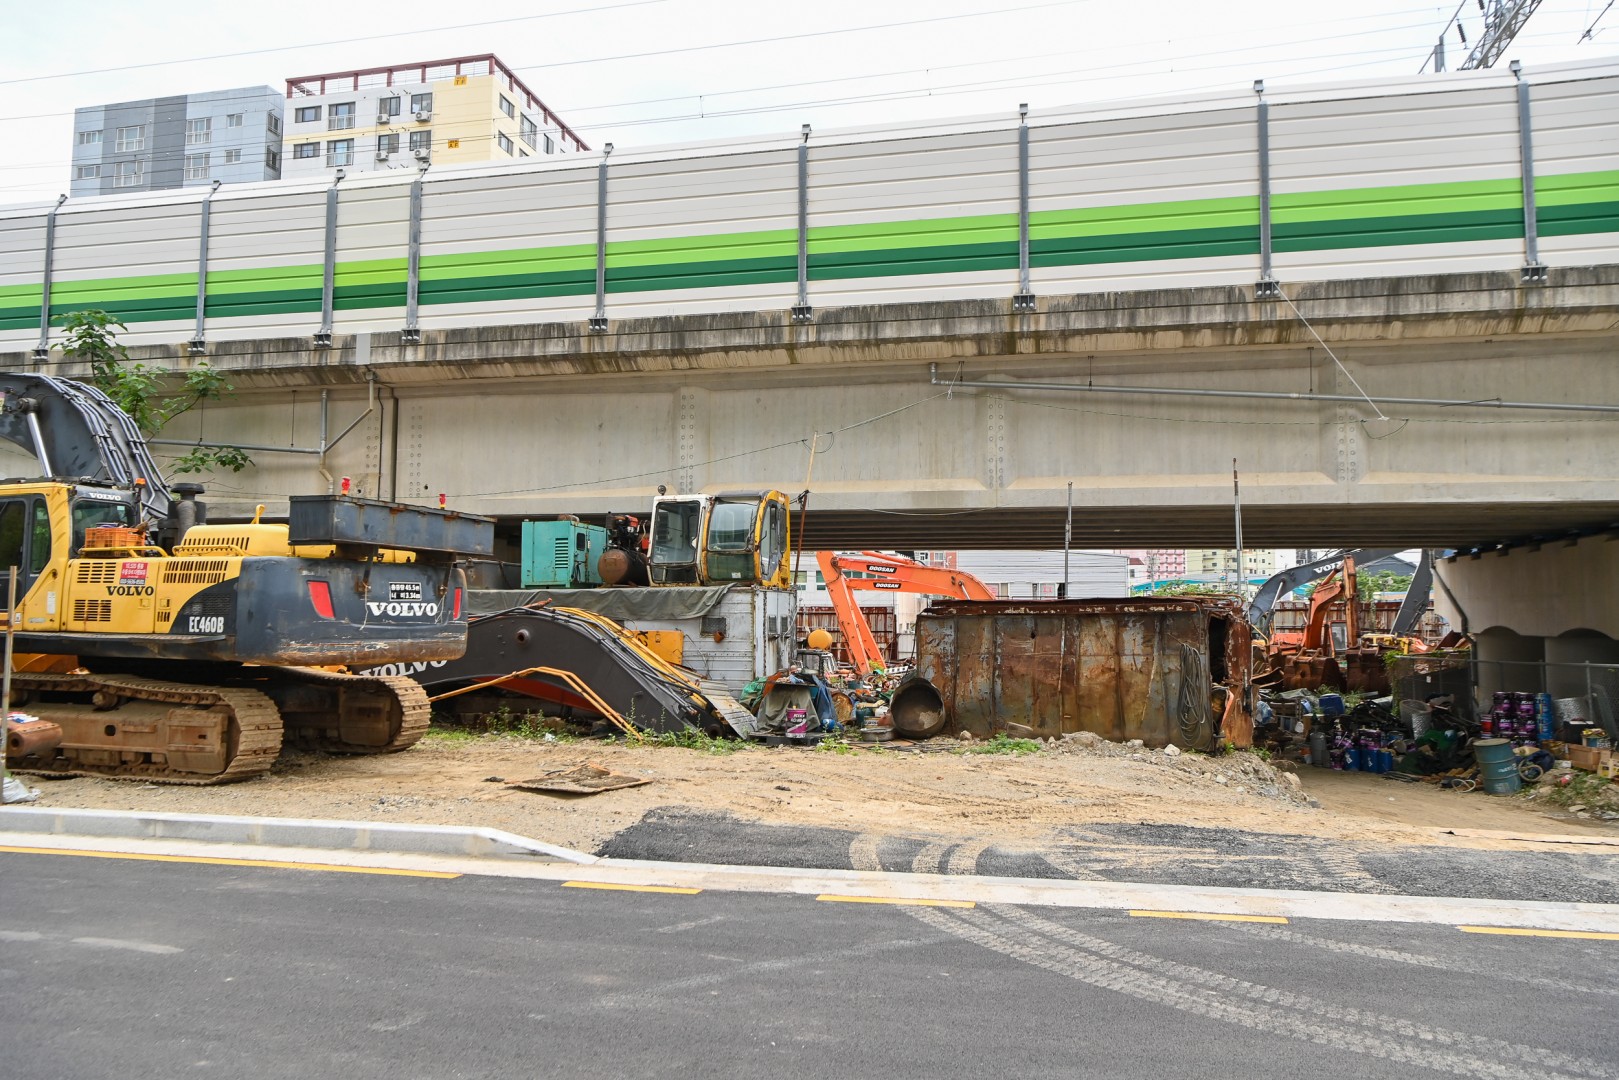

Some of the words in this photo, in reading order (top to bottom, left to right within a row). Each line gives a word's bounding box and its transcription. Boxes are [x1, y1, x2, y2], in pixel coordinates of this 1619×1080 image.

[89, 492, 121, 501] VOLVO
[106, 586, 154, 596] VOLVO
[367, 602, 437, 616] VOLVO
[189, 616, 224, 633] EC460B
